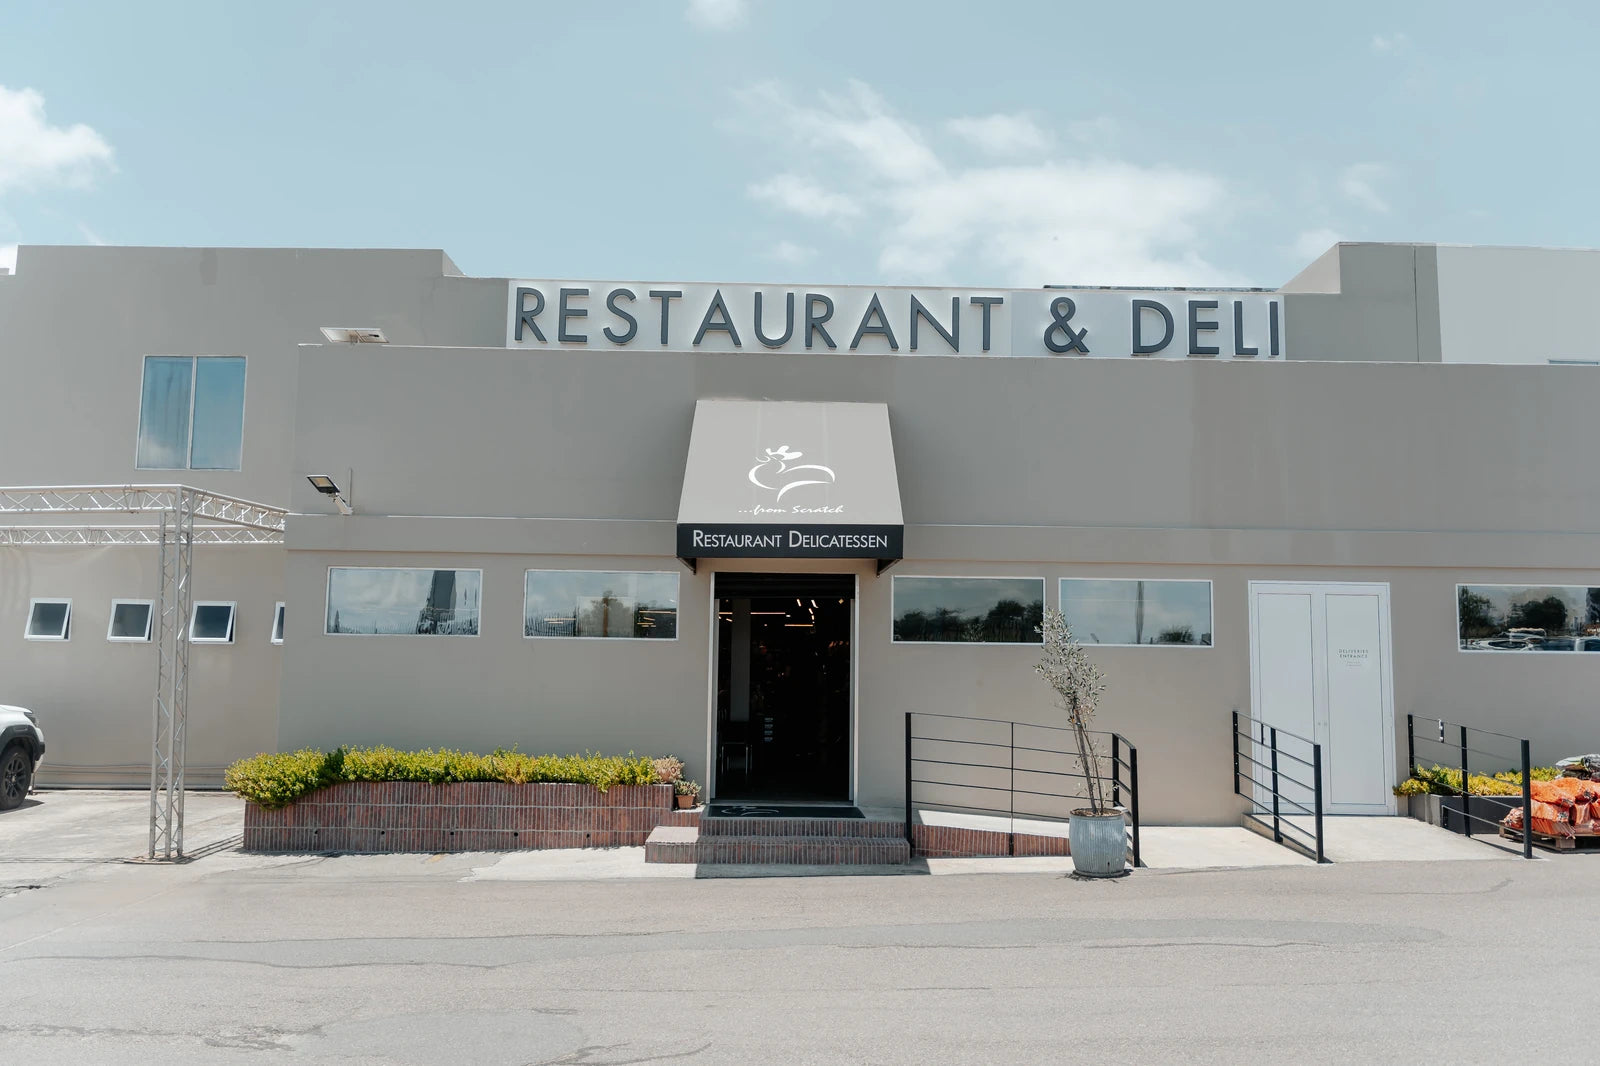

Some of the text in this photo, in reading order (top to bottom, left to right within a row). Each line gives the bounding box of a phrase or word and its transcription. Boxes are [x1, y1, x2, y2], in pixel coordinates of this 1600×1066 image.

[514, 287, 1280, 358] RESTAURANT & DELI
[792, 505, 844, 514] Scratch
